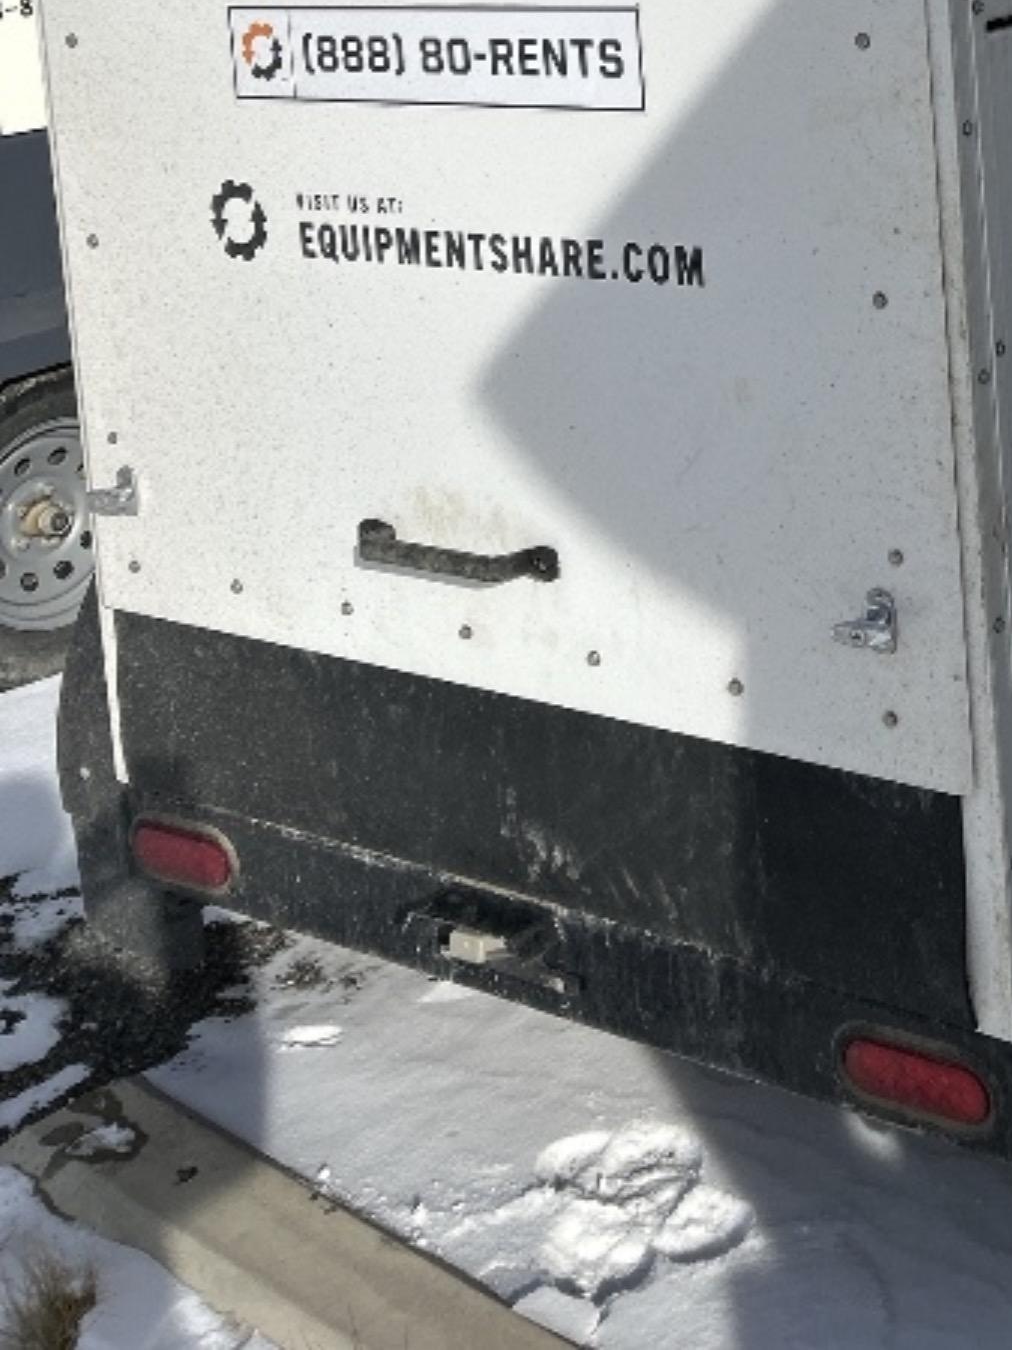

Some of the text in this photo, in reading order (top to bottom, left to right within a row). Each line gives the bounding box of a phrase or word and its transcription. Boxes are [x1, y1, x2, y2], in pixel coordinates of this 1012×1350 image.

[302, 33, 625, 79] (888) 80-RENTS
[296, 193, 403, 214] VISIT US AT:
[299, 221, 705, 287] EQUIPMENTSHARE.COM
